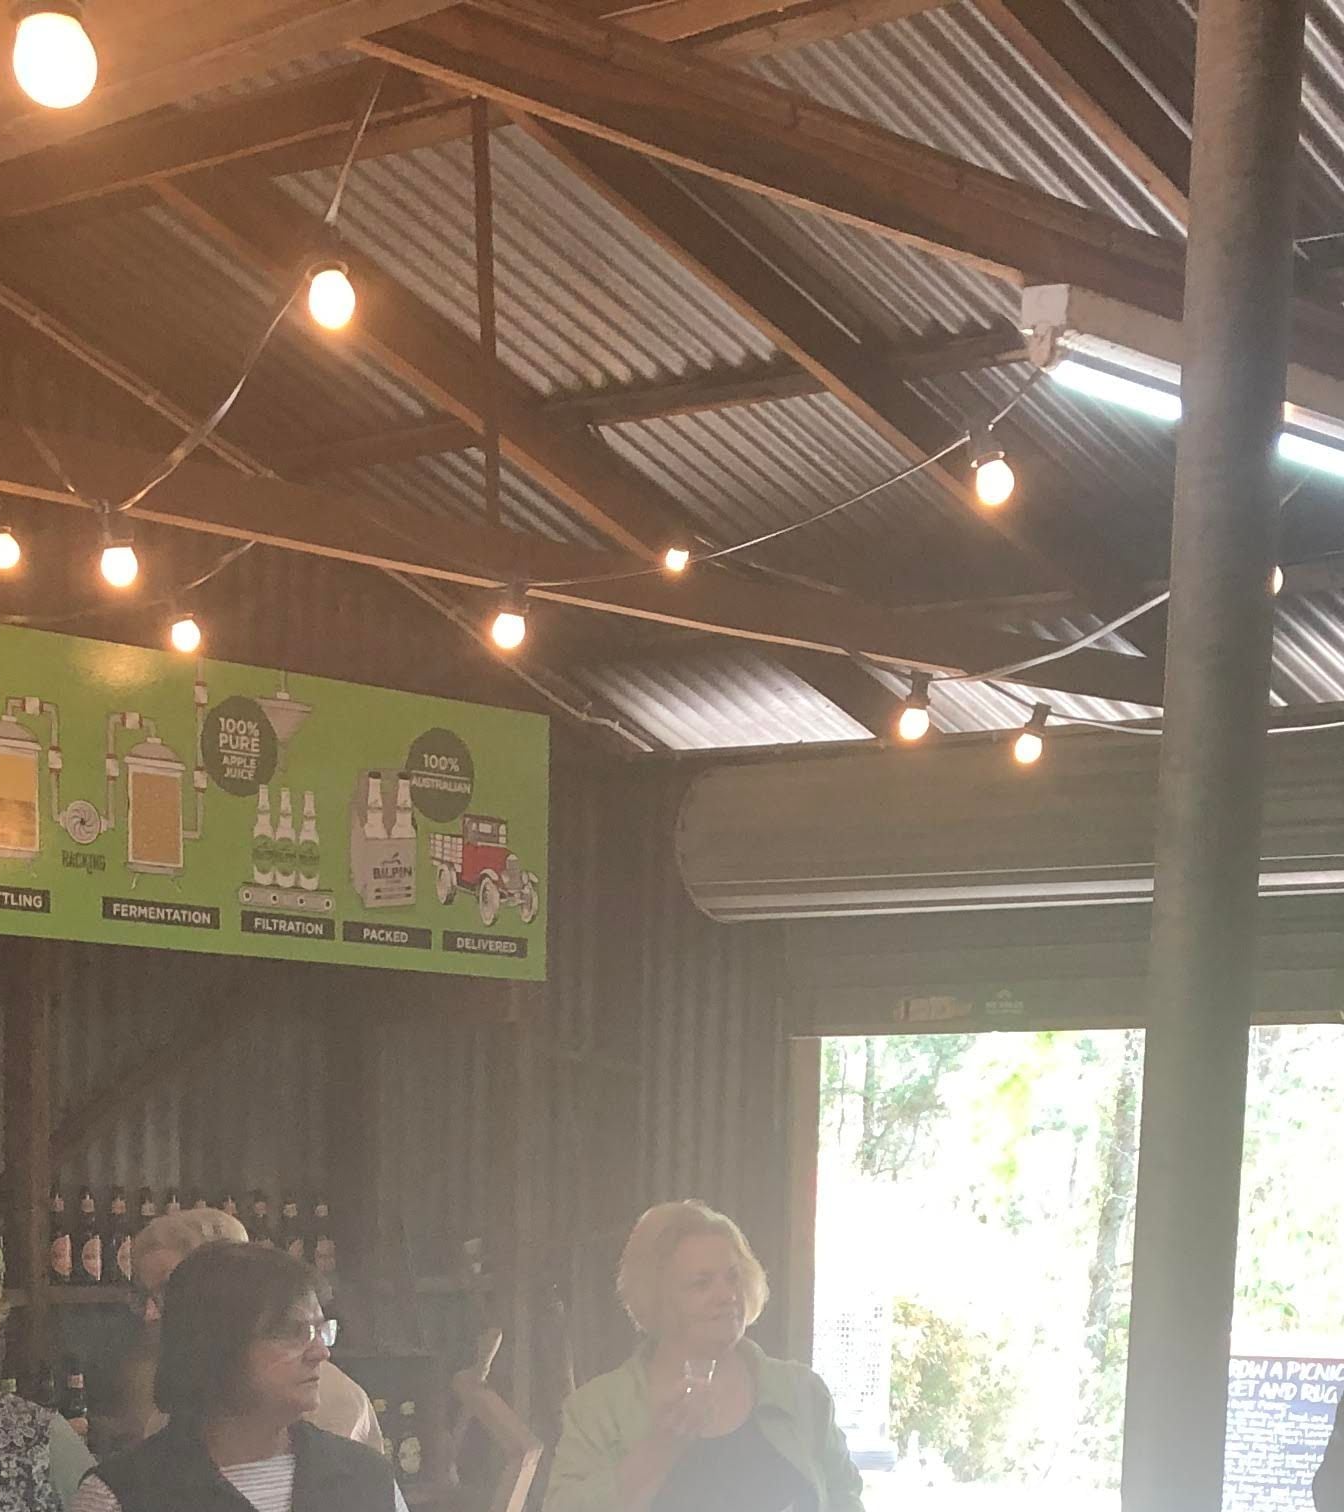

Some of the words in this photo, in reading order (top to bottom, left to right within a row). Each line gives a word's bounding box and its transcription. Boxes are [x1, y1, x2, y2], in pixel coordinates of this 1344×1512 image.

[218, 717, 260, 737] 100%
[218, 732, 260, 752] PURE
[222, 754, 257, 770] APPLE
[422, 753, 460, 773] 100%
[223, 767, 255, 782] JUICE
[411, 775, 471, 795] AUSTRALIAN
[112, 903, 212, 924] FERMENTATION
[254, 917, 324, 936] FILTRATION
[362, 928, 409, 943] PACKED
[456, 937, 517, 954] DELIVERED
[1269, 1361, 1283, 1380] A
[1258, 1381, 1298, 1401] AND
[1300, 1383, 1339, 1404] RUG
